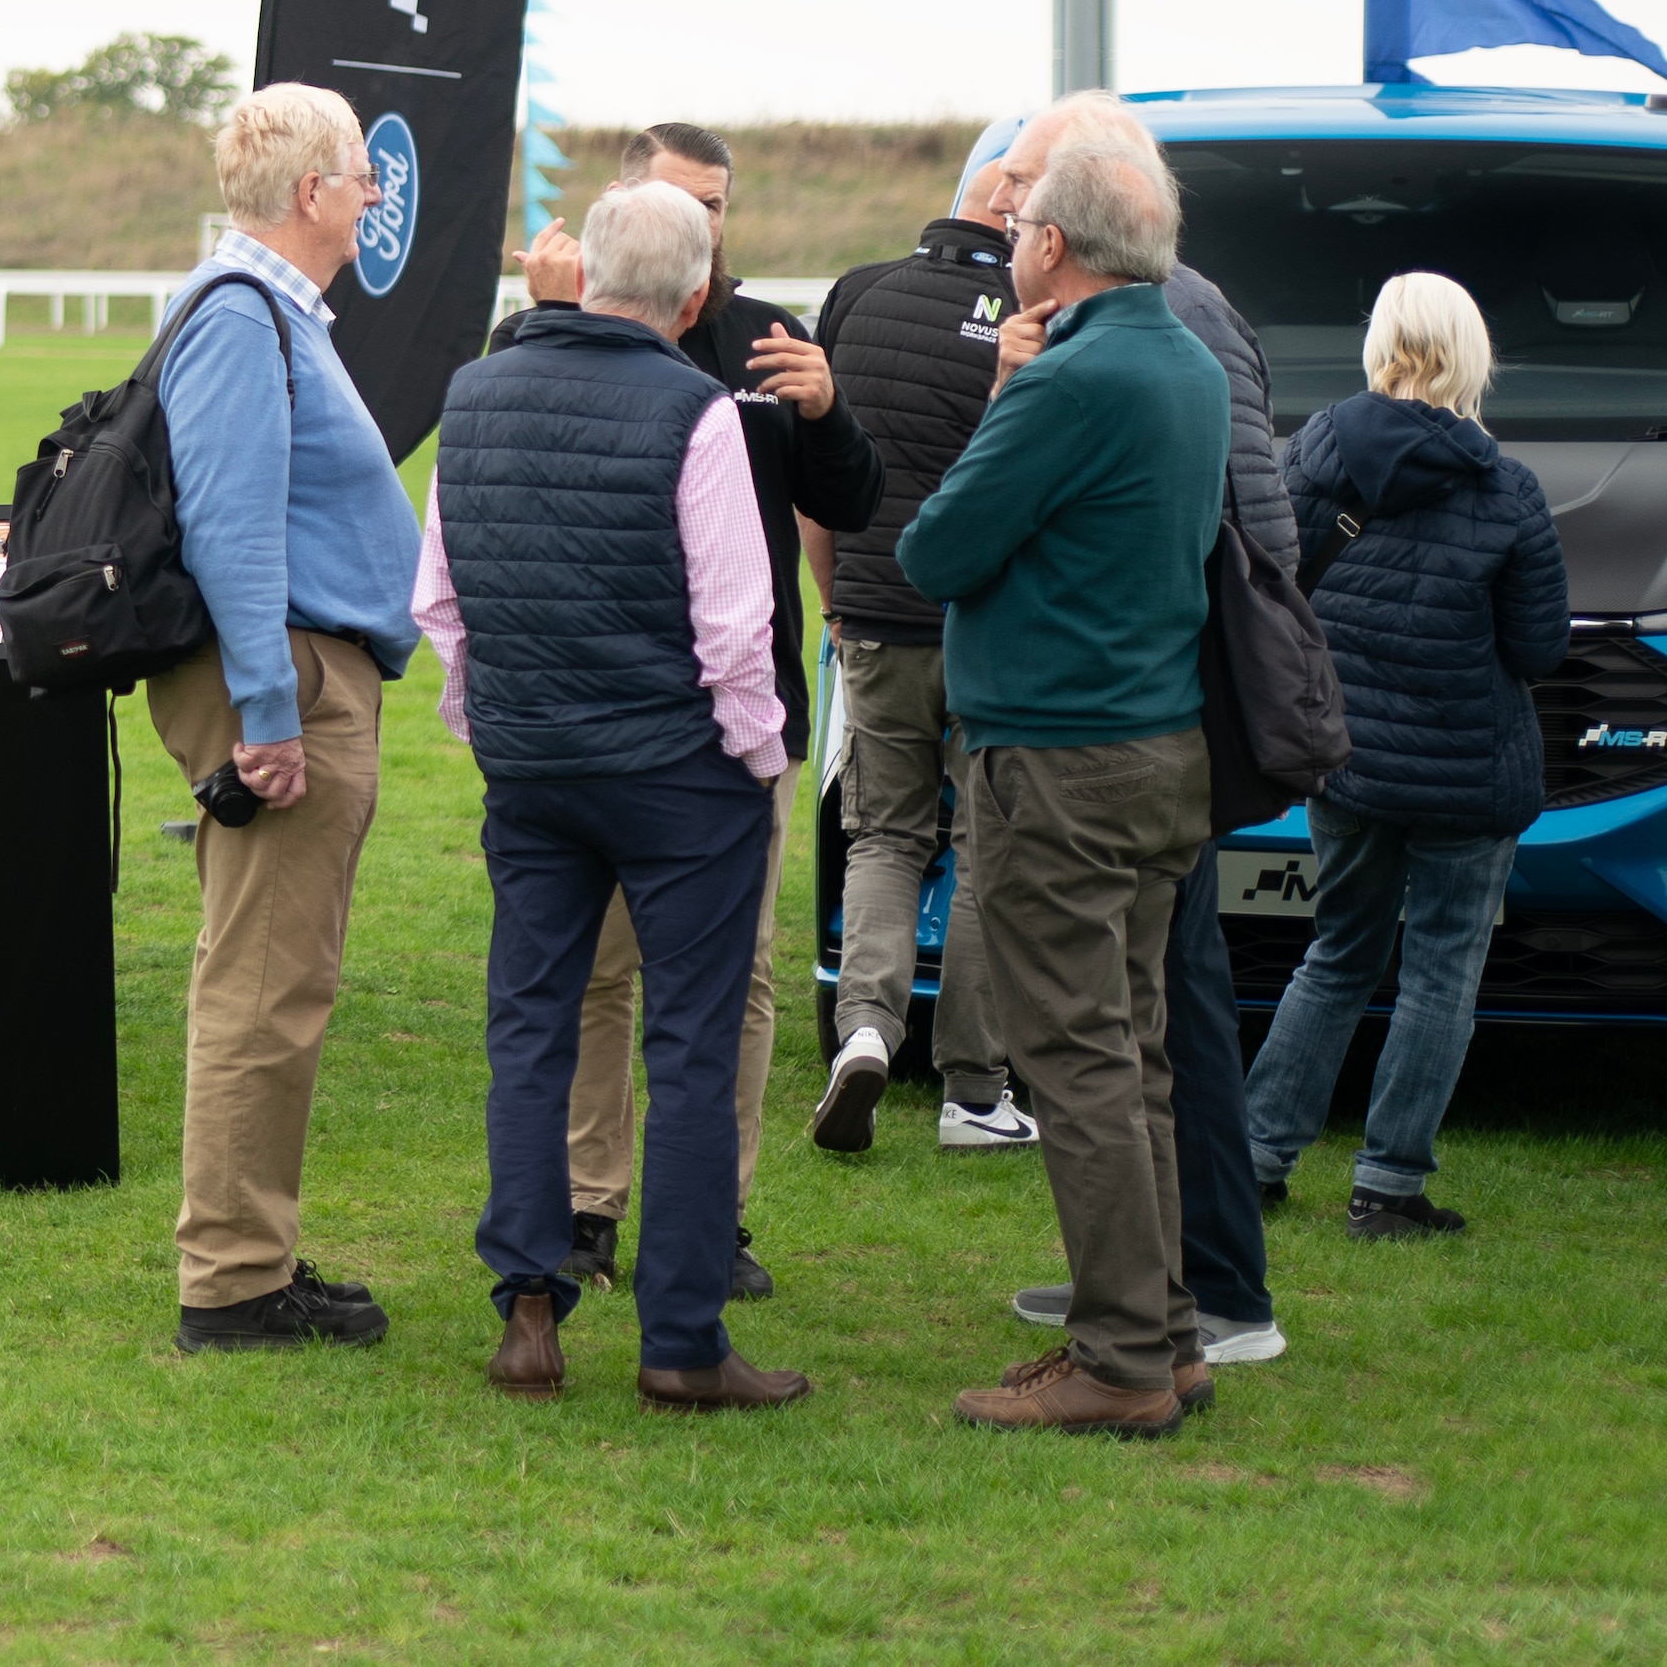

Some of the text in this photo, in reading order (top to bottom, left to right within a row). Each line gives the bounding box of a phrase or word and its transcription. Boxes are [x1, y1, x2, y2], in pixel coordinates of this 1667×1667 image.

[360, 146, 410, 262] Ford
[961, 321, 999, 337] NOVUS
[1597, 730, 1667, 747] MS-R
